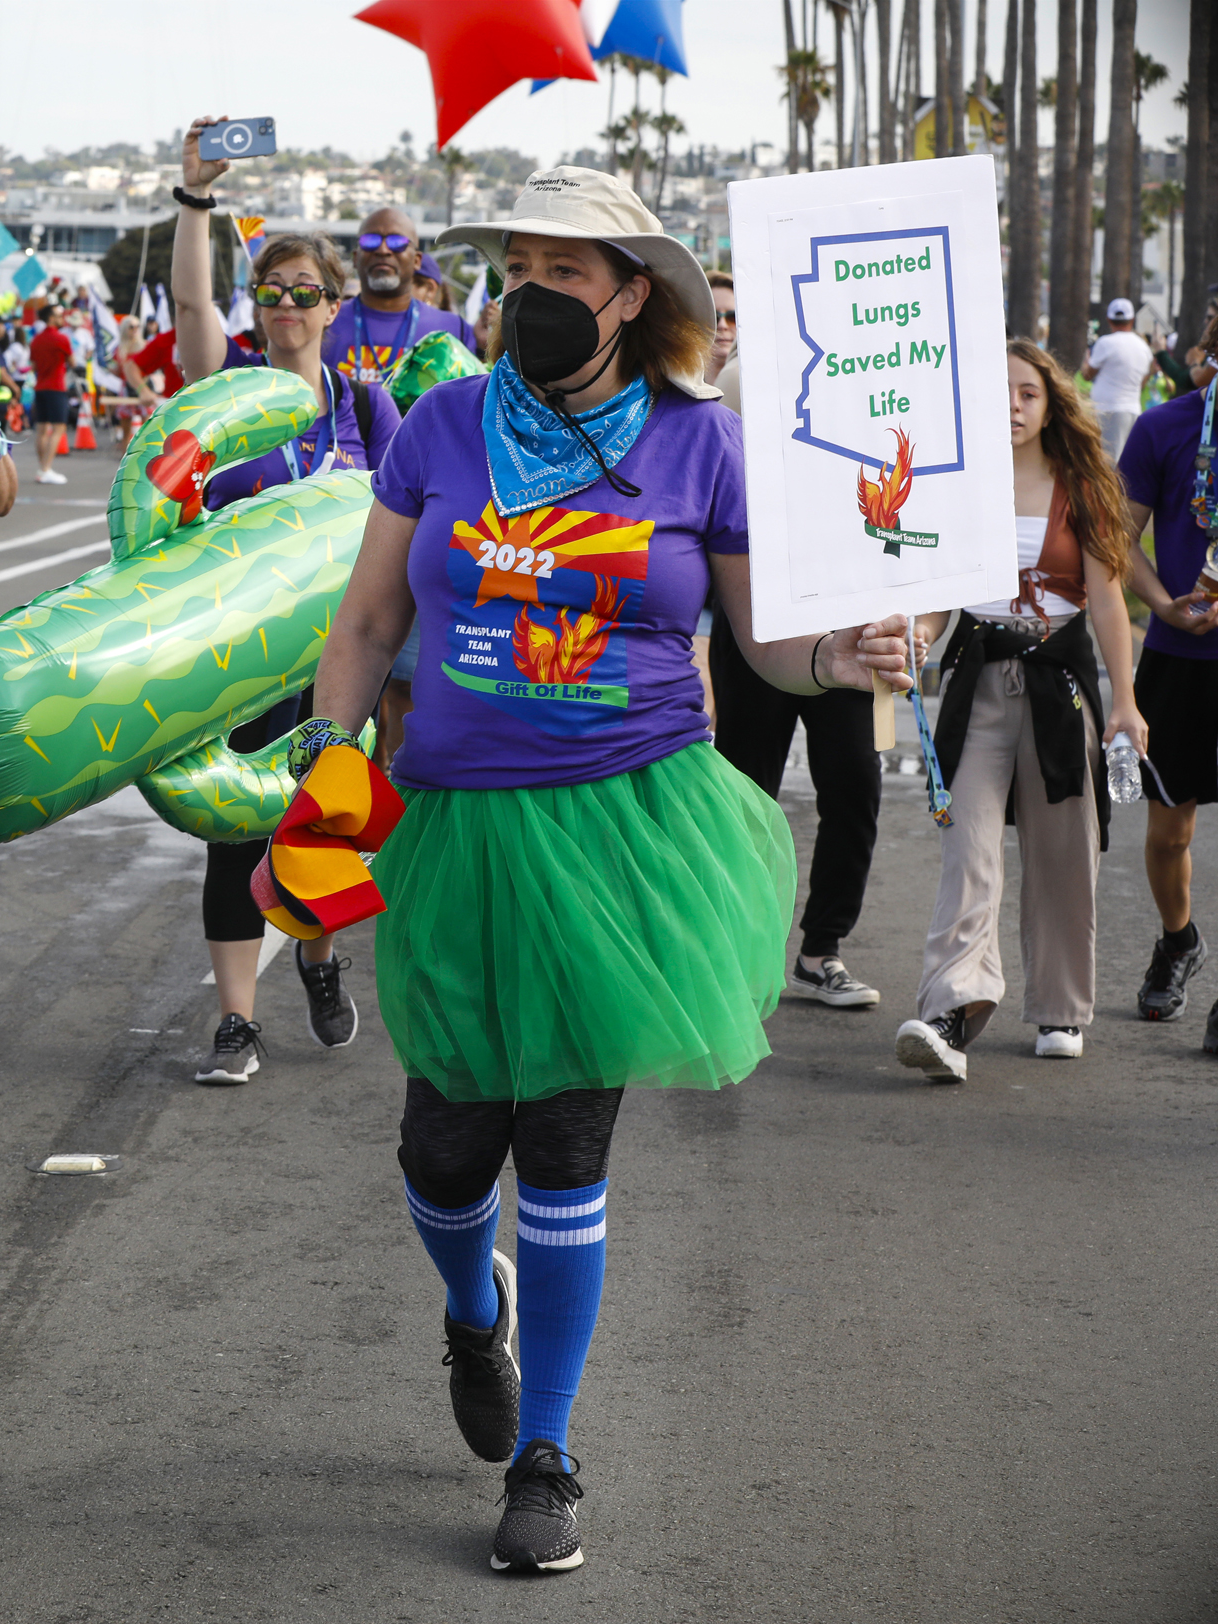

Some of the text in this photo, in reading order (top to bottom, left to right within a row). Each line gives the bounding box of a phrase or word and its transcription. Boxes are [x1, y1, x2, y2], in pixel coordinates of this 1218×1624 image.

[560, 179, 581, 187] Team
[834, 246, 931, 282] Donated
[851, 301, 922, 327] Lungs
[825, 339, 947, 377] Saved My
[868, 388, 911, 418] Life
[875, 527, 903, 542] Transplant
[902, 533, 916, 544] Team
[476, 540, 555, 579] 2022
[455, 625, 512, 638] TRANSPLANT
[467, 640, 492, 651] TEAM
[458, 653, 499, 667] ARIZONA
[495, 681, 603, 701] Gift Of Life
